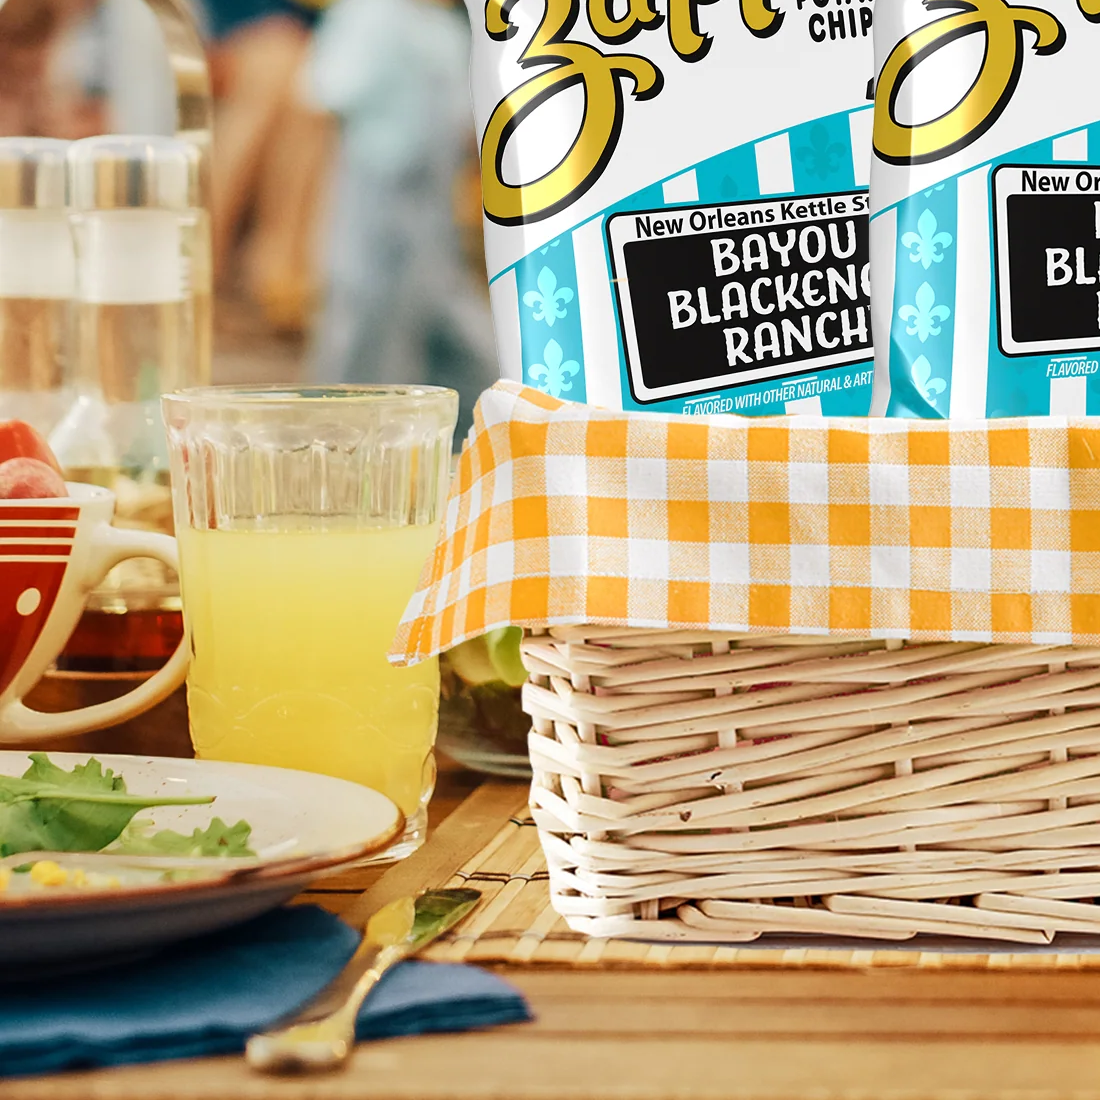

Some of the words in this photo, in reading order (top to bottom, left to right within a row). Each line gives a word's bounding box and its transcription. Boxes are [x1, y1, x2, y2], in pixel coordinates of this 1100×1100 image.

[808, 7, 873, 43] CHIP
[1021, 171, 1070, 192] New
[635, 216, 684, 238] New
[689, 208, 776, 231] Orleans
[780, 198, 846, 220] Kettle
[710, 220, 857, 277] BAYOU
[667, 262, 871, 330] BLACKEN
[723, 306, 869, 367] RANCH
[1046, 360, 1099, 377] FLAVORED
[735, 392, 762, 410] WITH
[763, 386, 796, 404] OTHER
[797, 379, 843, 398] NATURAL
[843, 376, 852, 388] &
